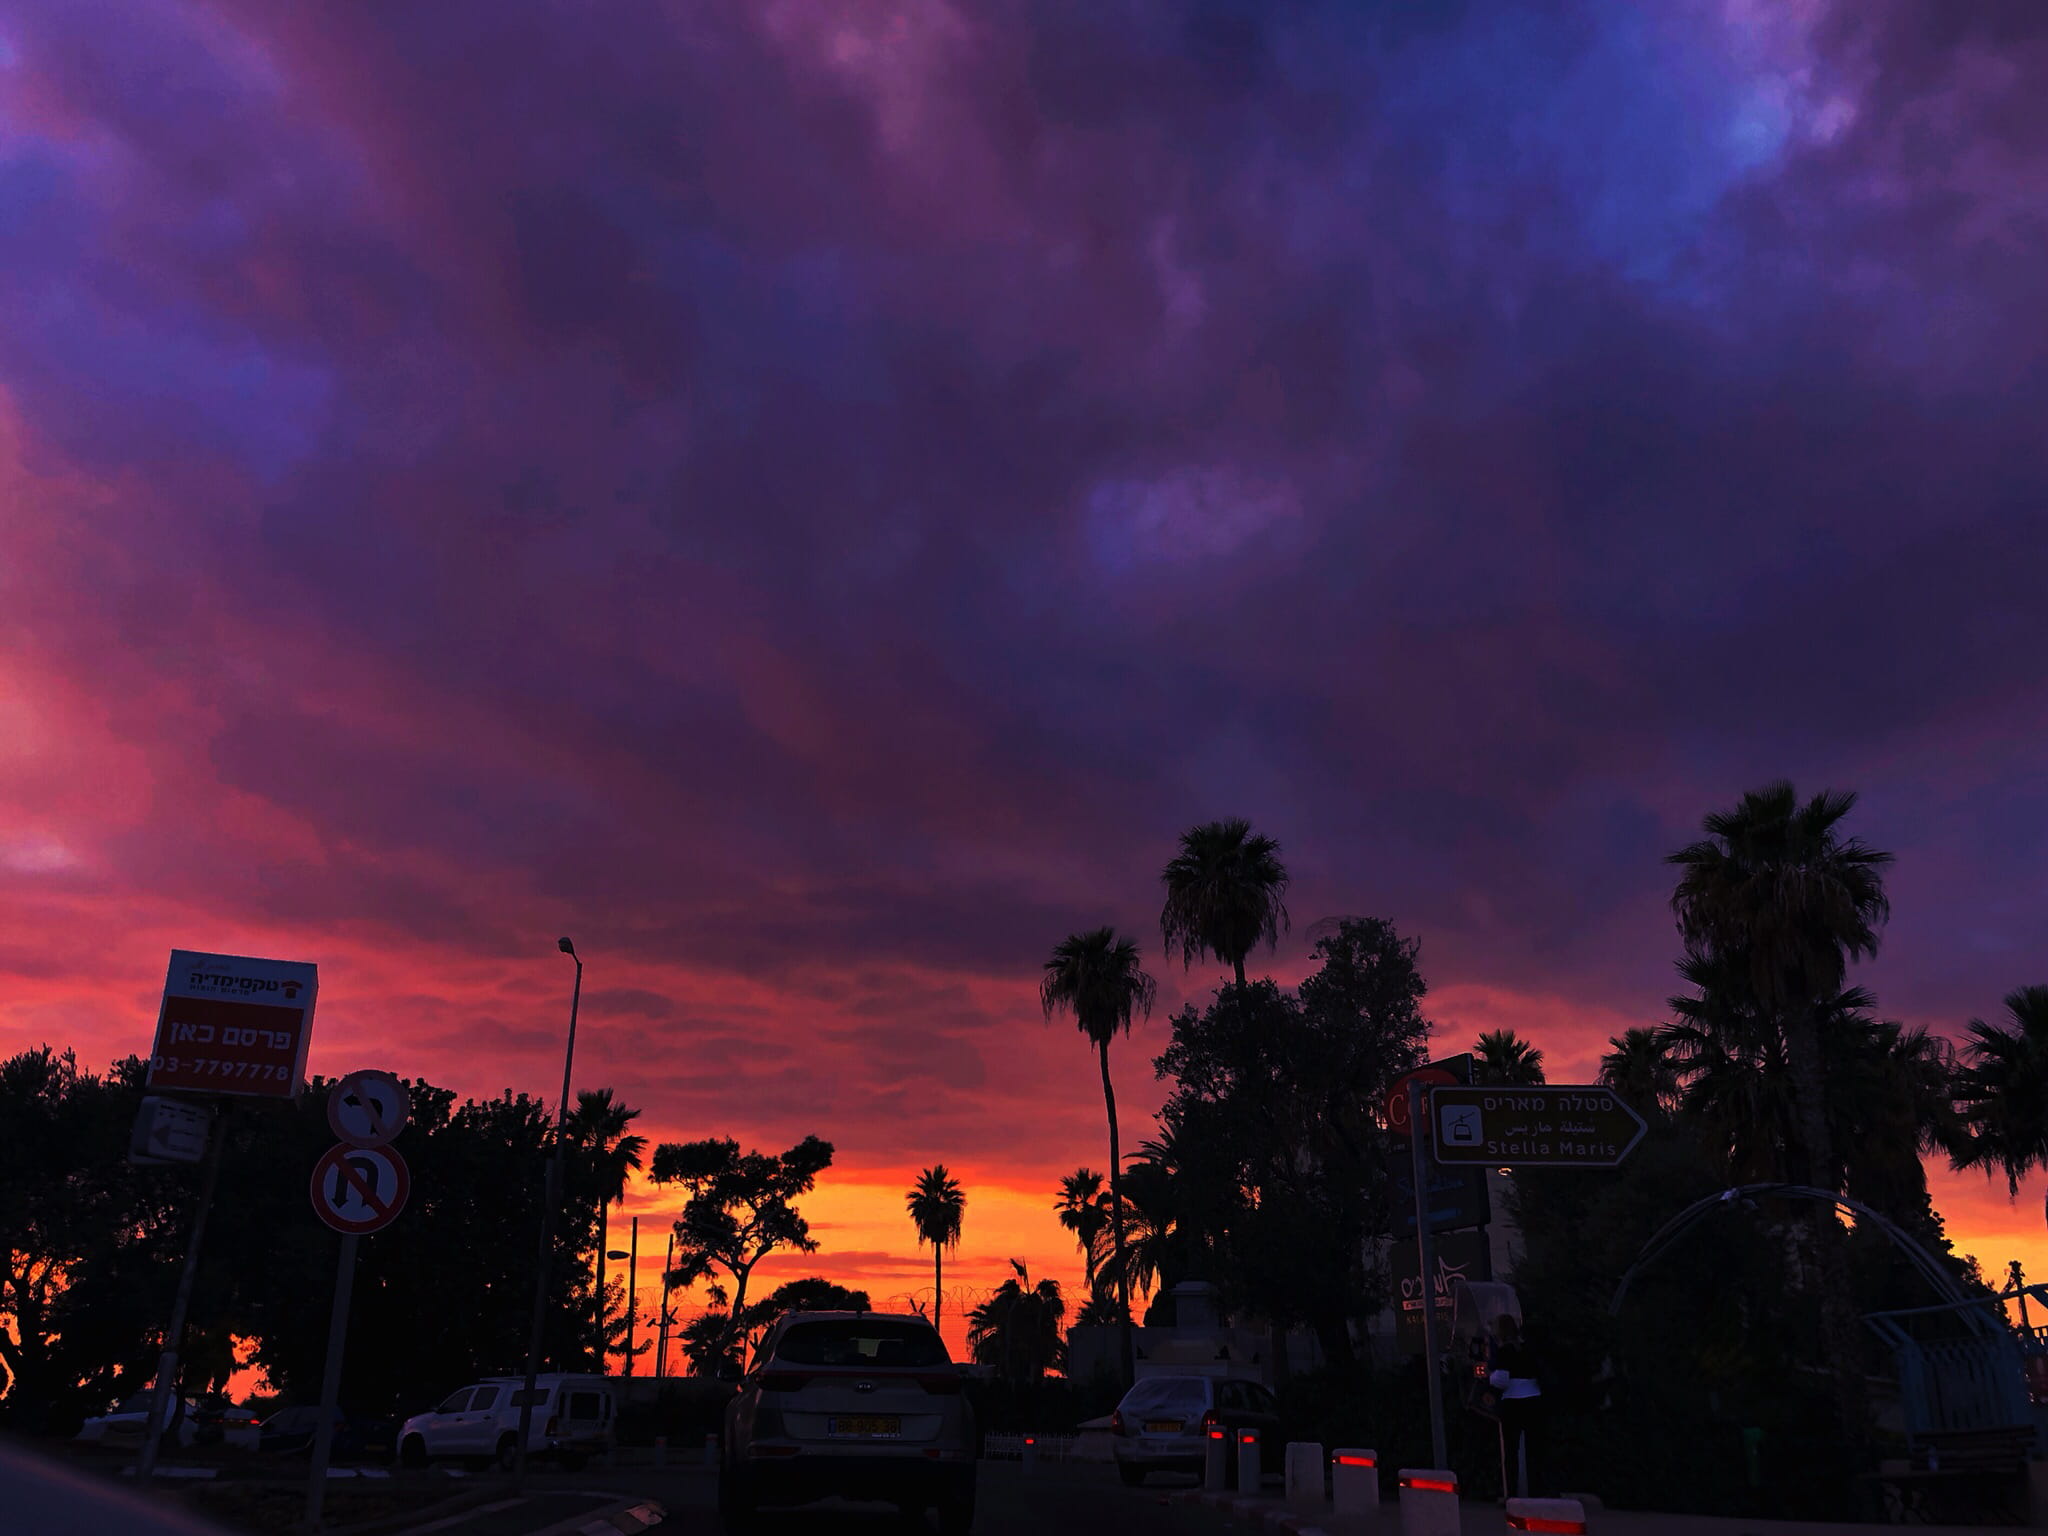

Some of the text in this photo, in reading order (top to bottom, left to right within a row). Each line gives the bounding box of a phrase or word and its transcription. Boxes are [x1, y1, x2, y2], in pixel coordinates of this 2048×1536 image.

[170, 1022, 291, 1050] פרסם כאן
[153, 1056, 289, 1081] 03-7797778
[1483, 1093, 1614, 1111] סטלה מאריס
[1487, 1139, 1617, 1156] Stella Maris
